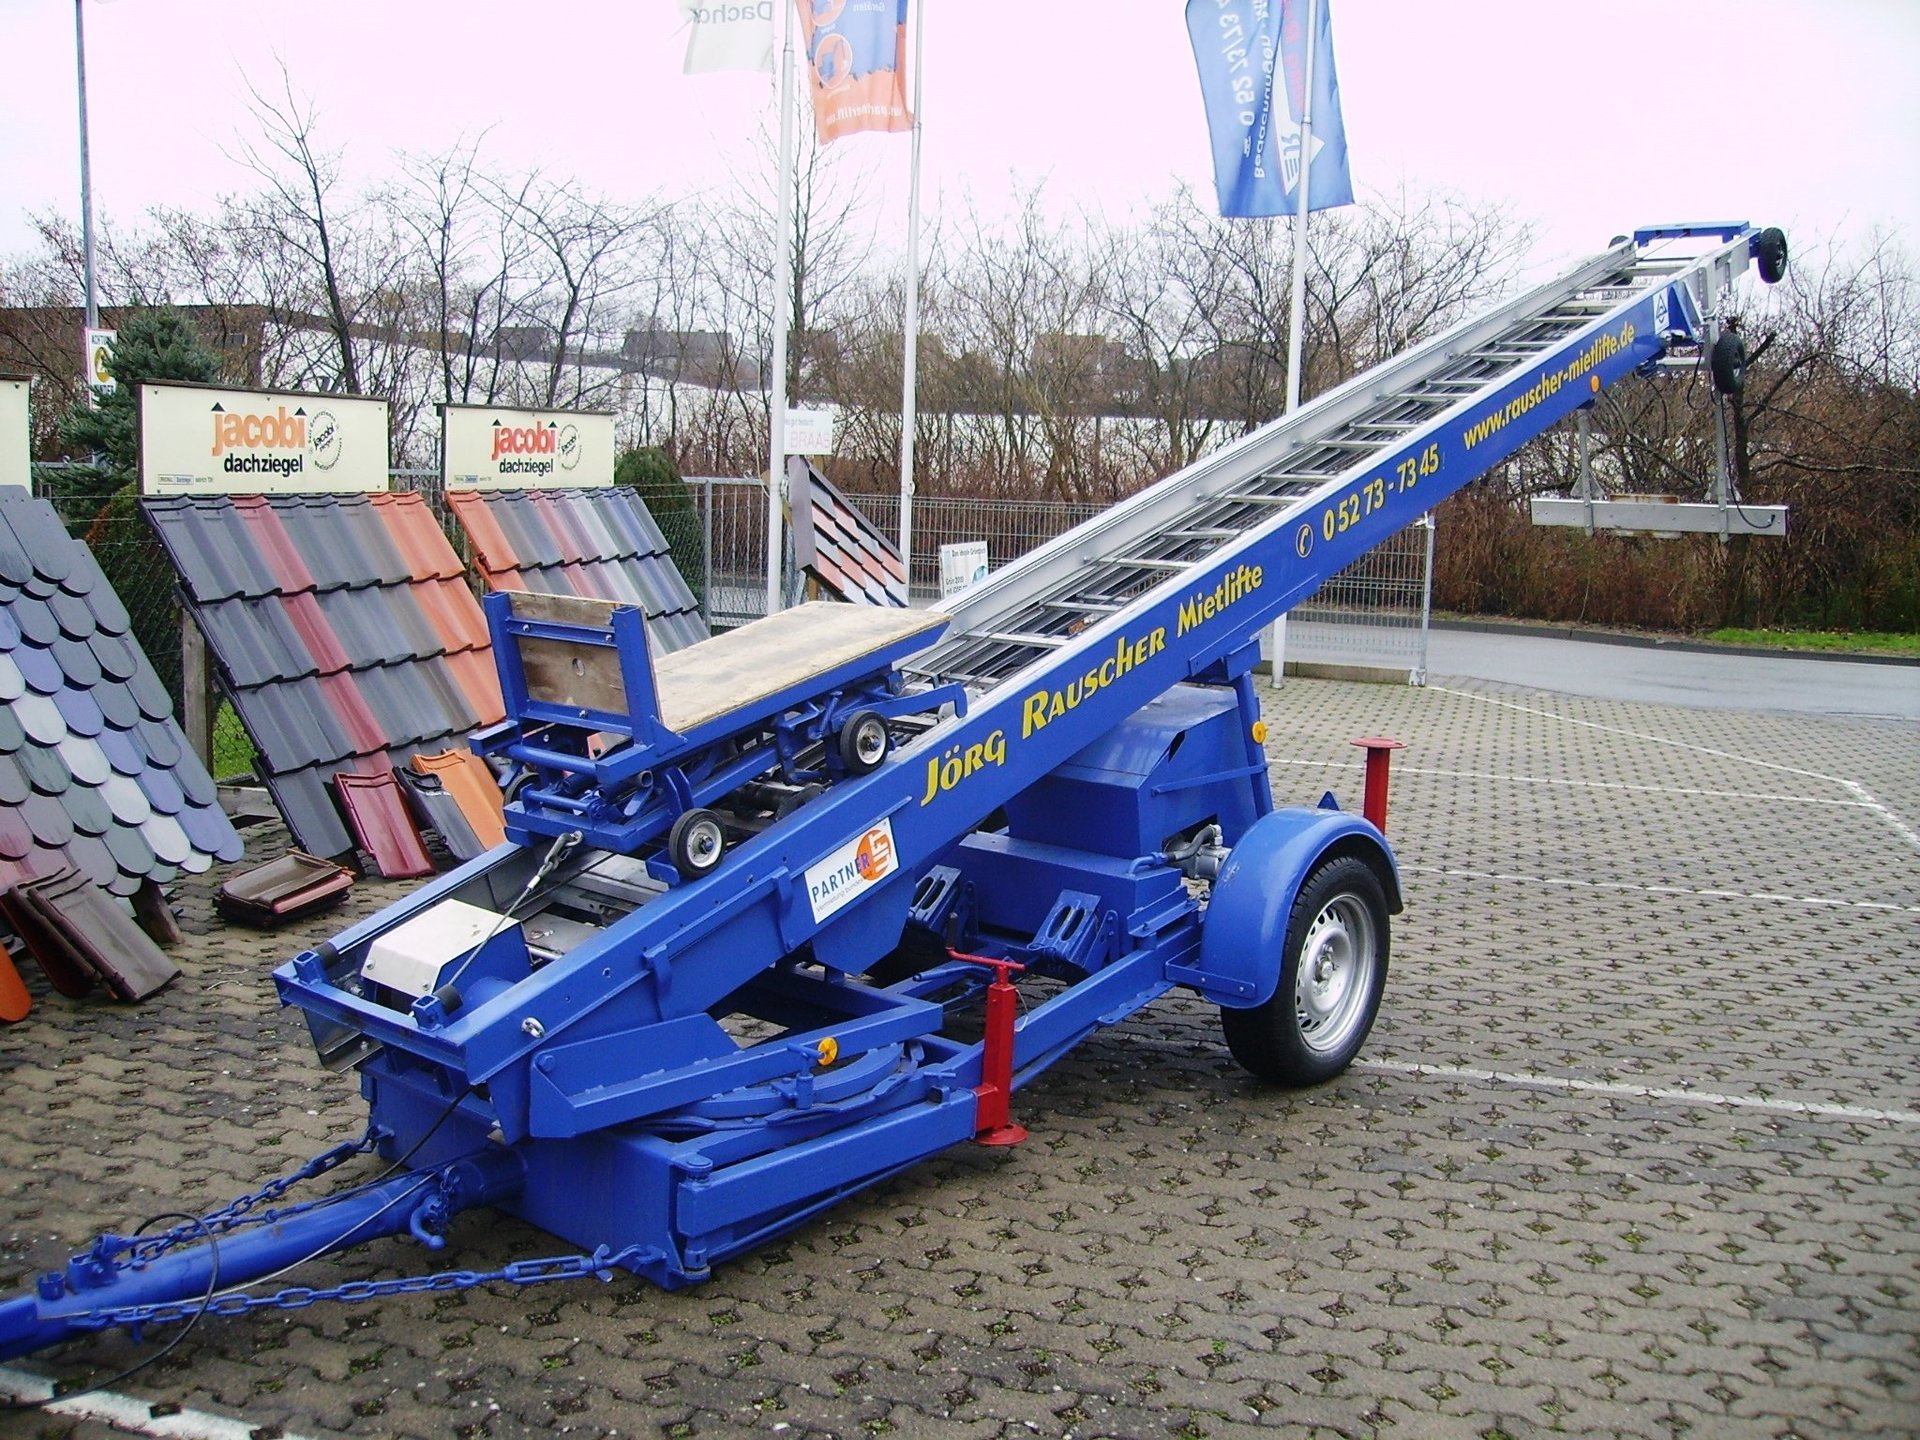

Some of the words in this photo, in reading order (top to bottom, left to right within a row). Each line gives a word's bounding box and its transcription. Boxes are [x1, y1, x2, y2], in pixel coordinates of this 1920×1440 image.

[1463, 320, 1636, 451] www.rauscher-mietlifte.de
[211, 402, 306, 456] jacobi
[491, 419, 558, 461] jacobi
[224, 453, 303, 477] dachziegel
[499, 458, 554, 476] dachziegel
[1419, 443, 1440, 477] 45
[1177, 564, 1264, 638] Mietlifte
[811, 852, 871, 904] PARTNER
